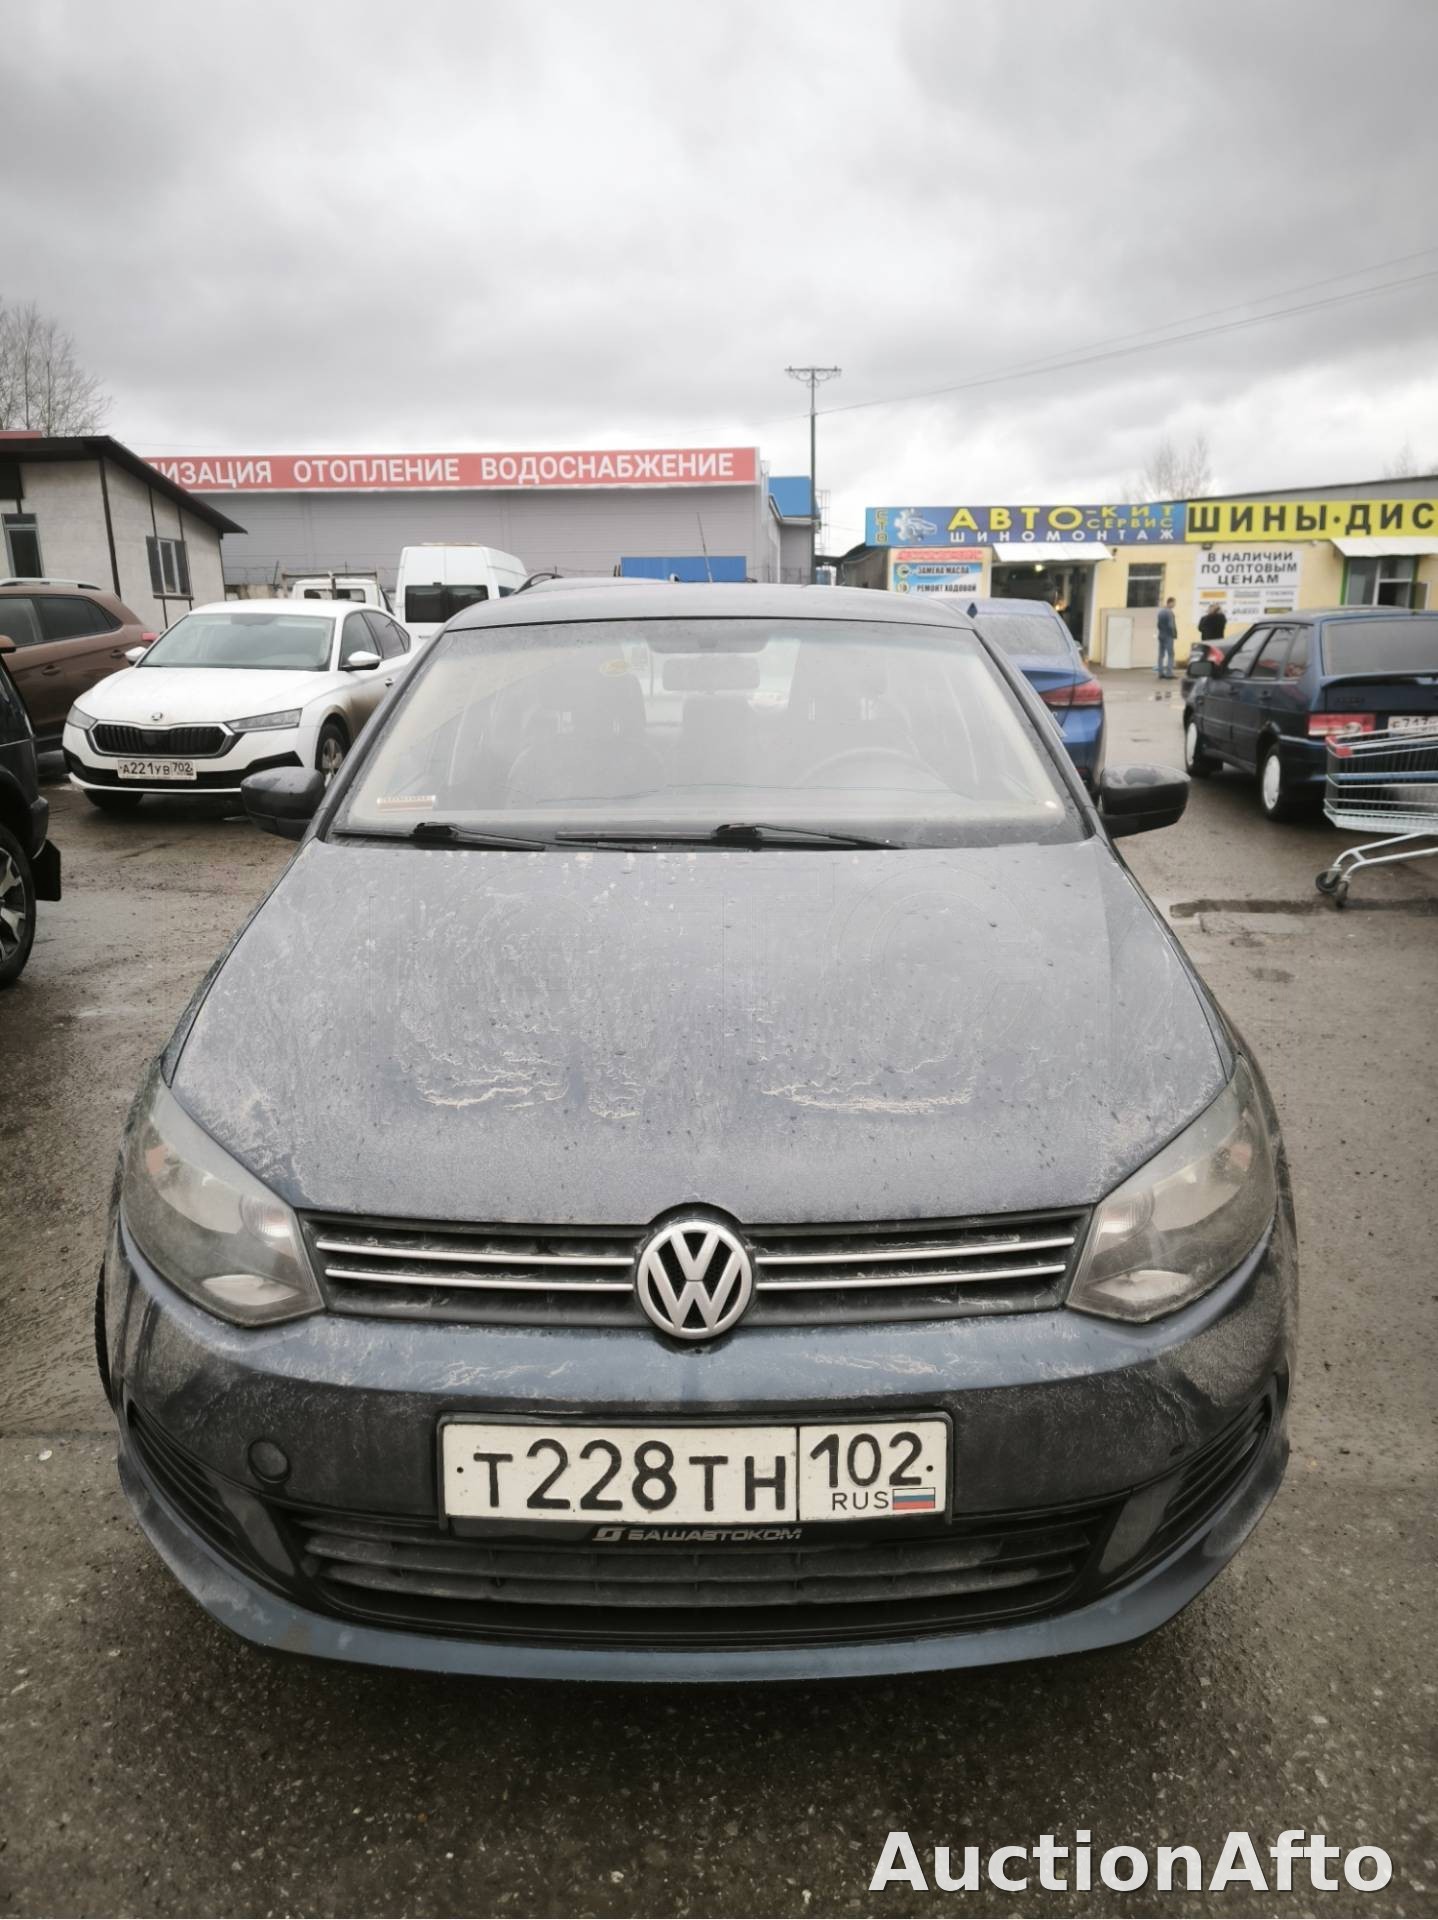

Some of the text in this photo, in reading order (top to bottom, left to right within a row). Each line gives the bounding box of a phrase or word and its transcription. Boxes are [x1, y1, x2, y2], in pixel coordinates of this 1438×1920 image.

[293, 458, 460, 483] ОТОПЛЕНИЕ
[480, 453, 734, 484] ВОДОСНАБЖЕНИЕ
[1086, 517, 1174, 530] СЕРВИС
[949, 529, 1175, 543] ШИНОМОНТАЖ
[1207, 551, 1293, 562] В НАЛИЧИИ
[1201, 562, 1297, 574] ПО ОПТОВЫМ
[1217, 574, 1279, 586] ЦЕНАМ
[917, 584, 943, 592] РЕМОНТ
[474, 1432, 922, 1511] Т228ТН 102
[831, 1491, 889, 1511] RUS
[628, 1527, 802, 1542] БАШАВТОКОМ
